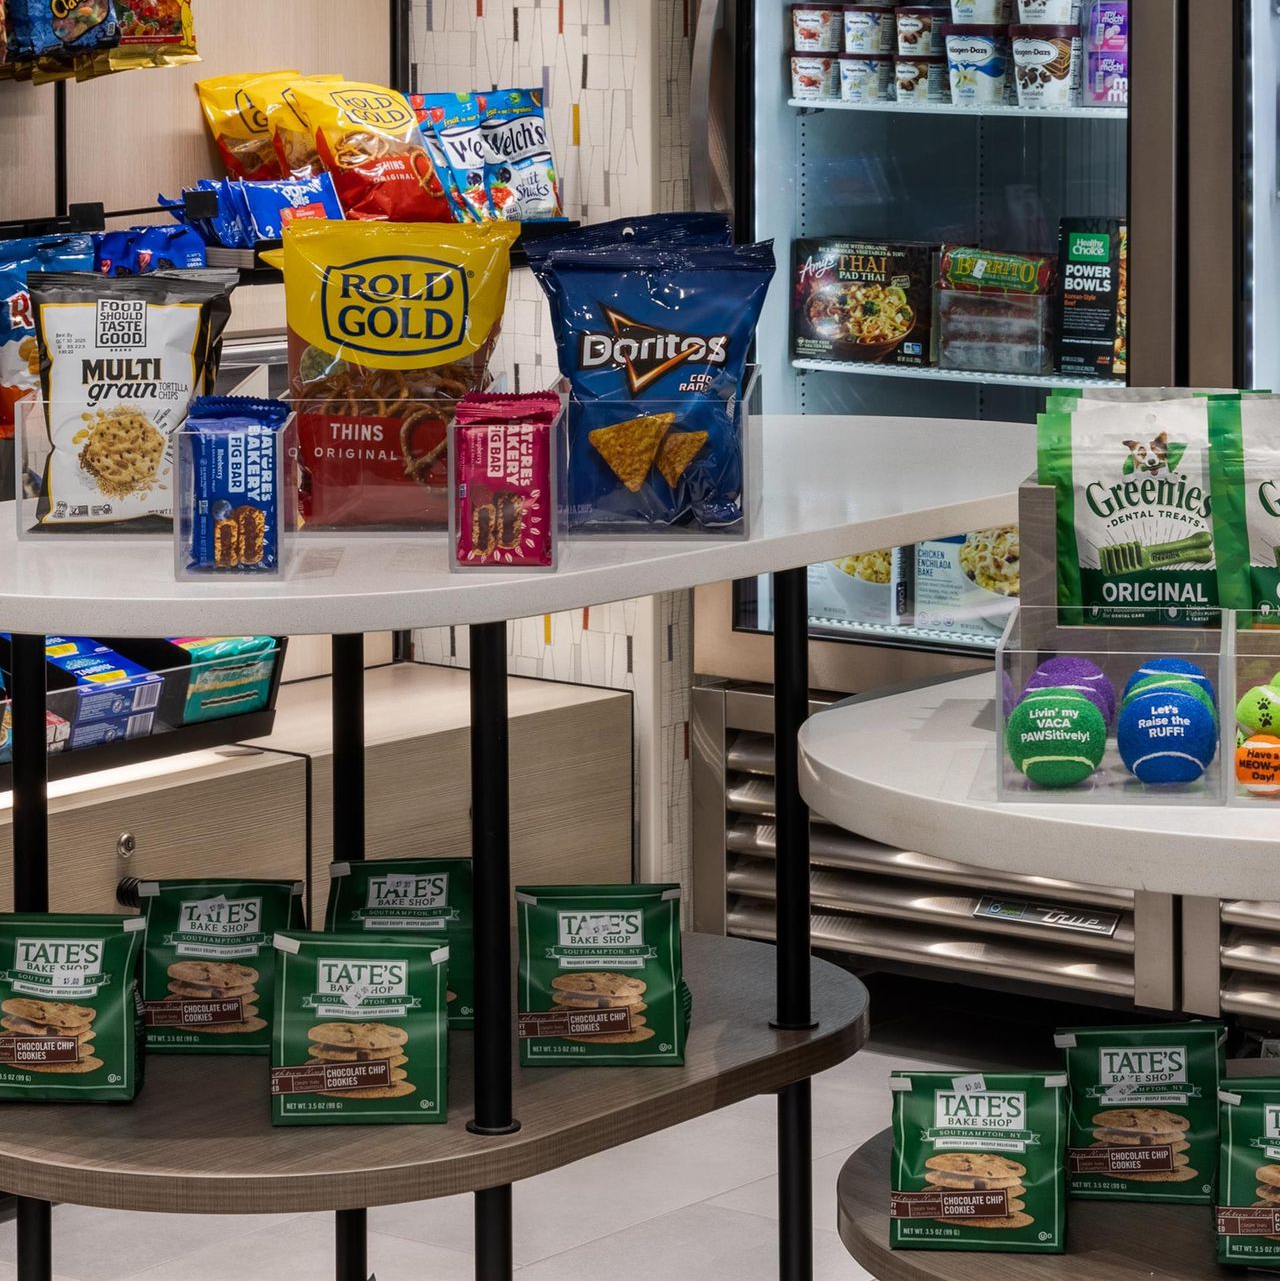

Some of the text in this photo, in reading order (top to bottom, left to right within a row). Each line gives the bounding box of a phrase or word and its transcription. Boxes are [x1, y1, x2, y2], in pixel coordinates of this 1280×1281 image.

[1076, 238, 1104, 248] Healthy
[1073, 245, 1105, 256] Choice
[838, 254, 887, 273] THAI
[839, 271, 885, 281] PAD THAI
[1066, 265, 1110, 278] POWER
[340, 271, 453, 302] ROLD
[1065, 278, 1111, 292] BOWLS
[100, 300, 142, 313] FOOD
[99, 311, 143, 321] SHOULD
[338, 305, 453, 340] GOLD
[100, 320, 142, 333] TASTE
[99, 331, 144, 345] GOOD.
[582, 334, 728, 366] Doritos
[81, 358, 161, 385] MULTI
[159, 382, 188, 391] TORTILLA
[88, 381, 157, 407] grain
[159, 391, 178, 400] CHIPS
[330, 423, 383, 441] THINS
[314, 447, 398, 461] ORIGINAL
[231, 437, 242, 488] FIG BAR
[248, 425, 261, 501] BAKERY
[1029, 709, 1079, 721] Livin' my
[1151, 705, 1178, 716] Let's
[1036, 718, 1071, 728] VACA
[1138, 716, 1190, 727] Raise the
[1021, 730, 1090, 744] PAWSitively!
[1150, 726, 1185, 738] RUFF!
[938, 1094, 1022, 1119] TATE'S
[948, 1117, 1012, 1127] BAKE SHOP
[943, 1194, 1004, 1207] CHOCOLATE CHIP
[944, 1204, 975, 1215] COOKIES
